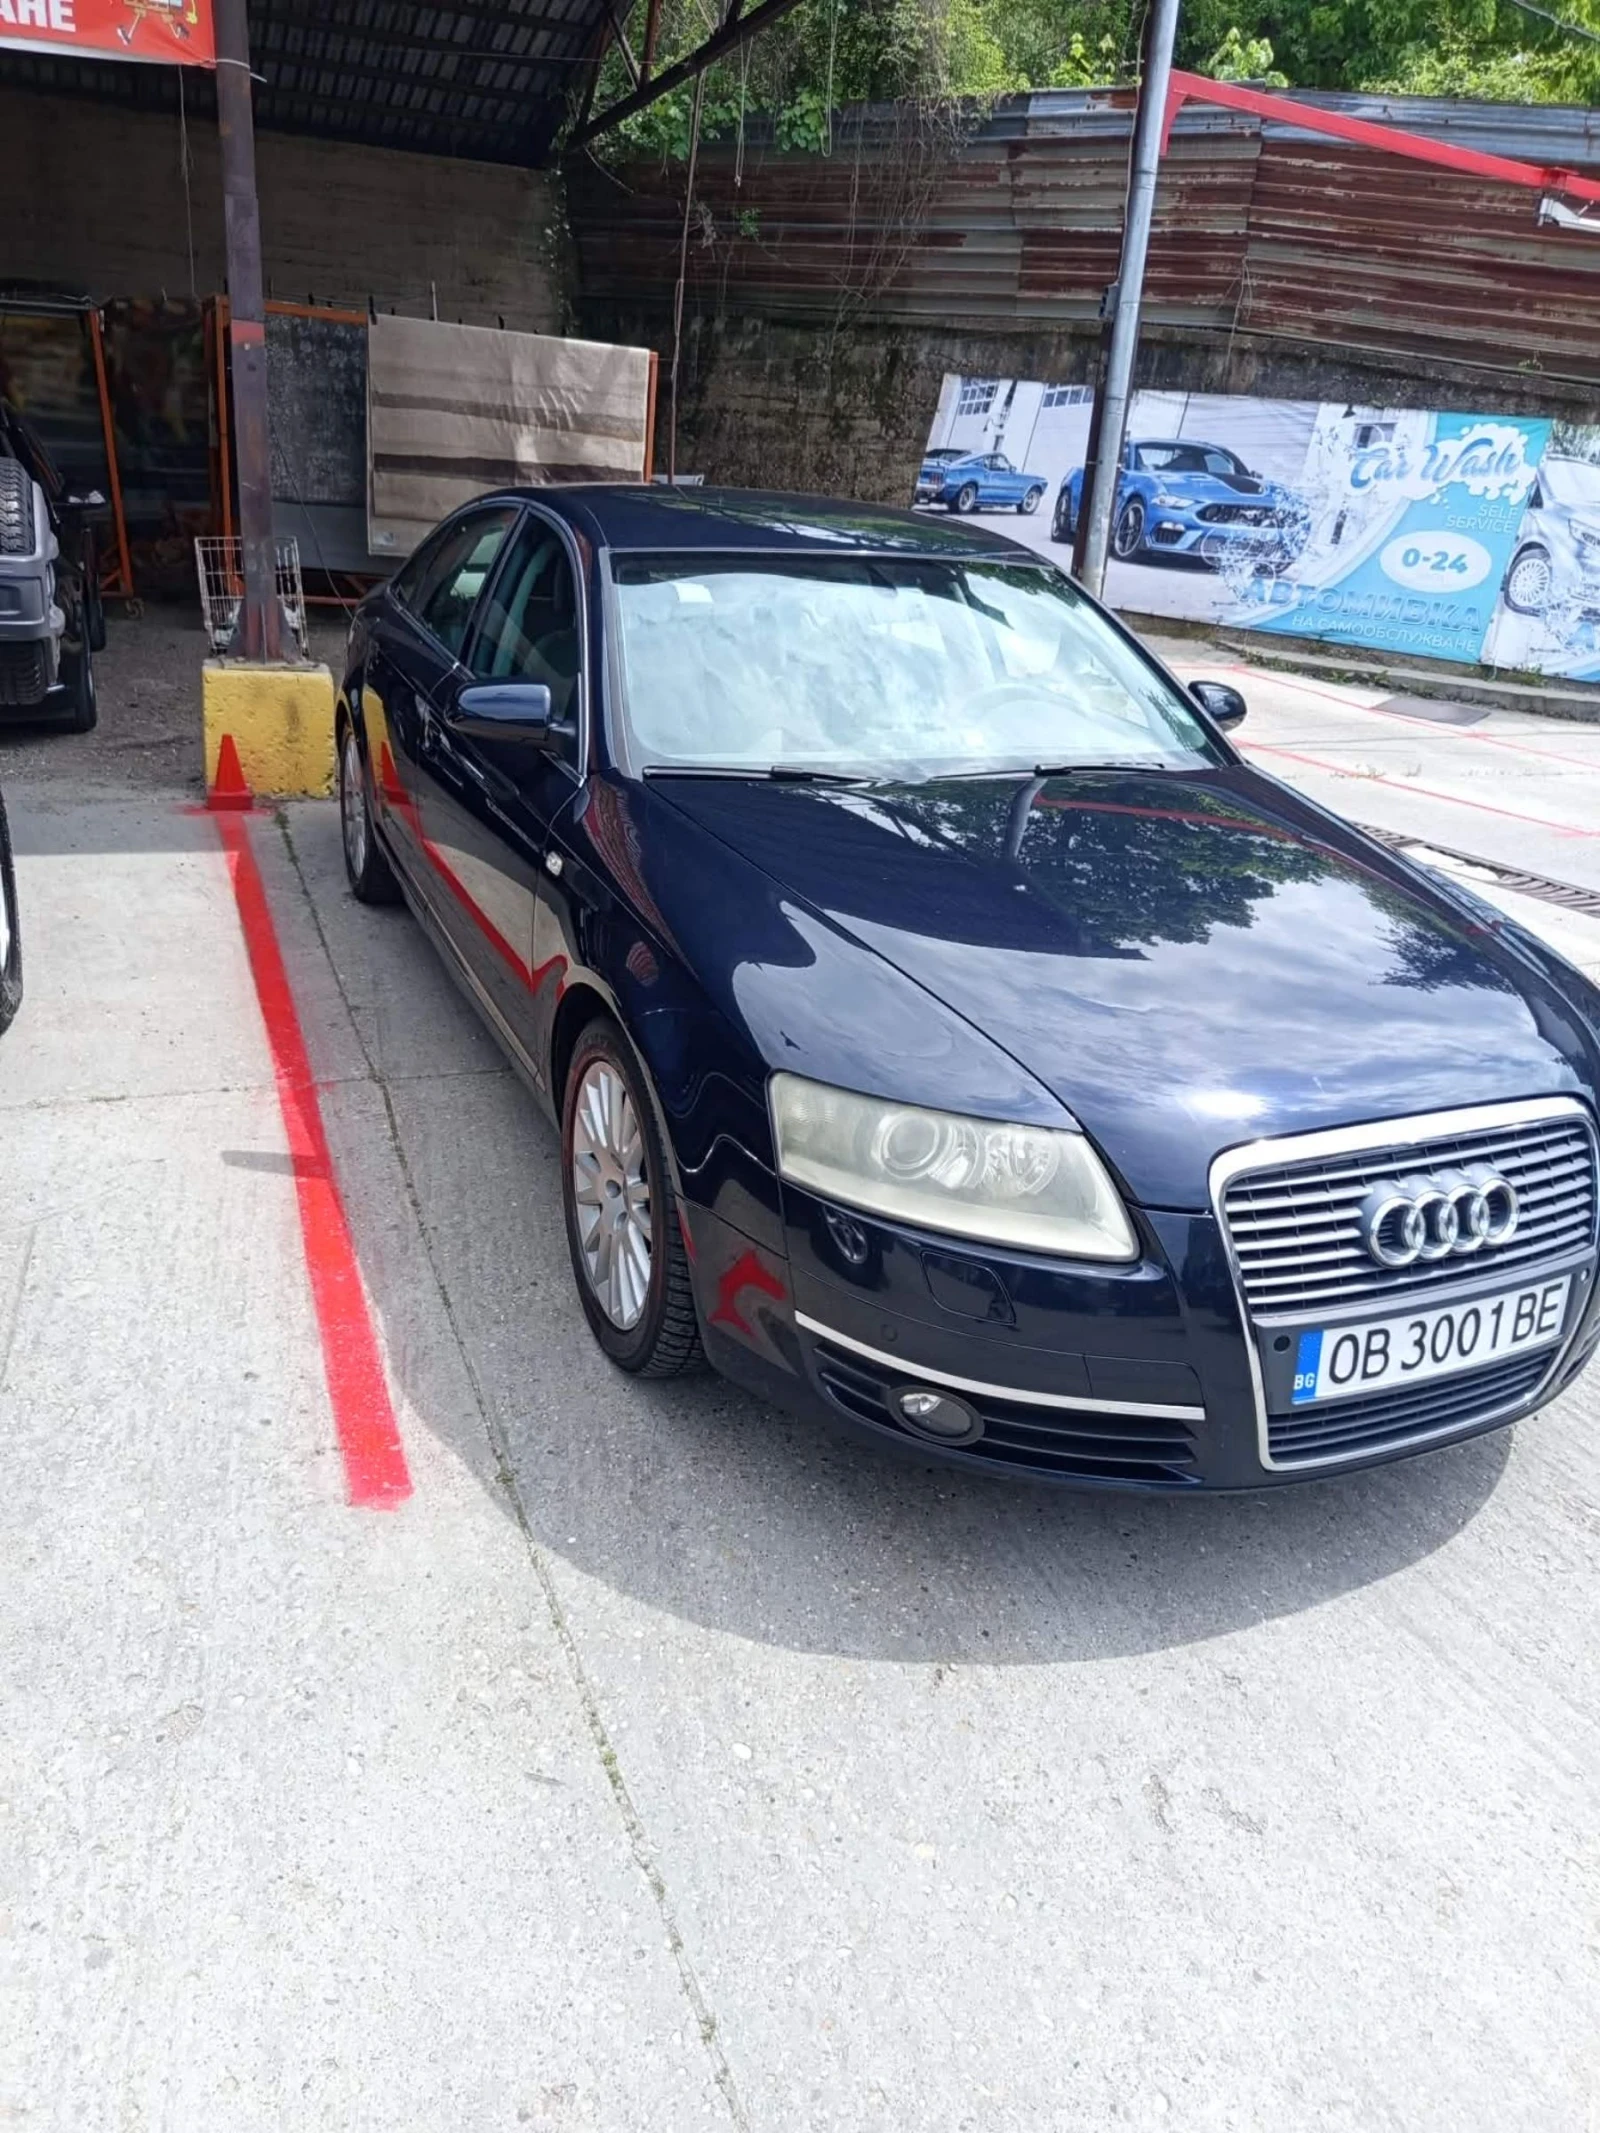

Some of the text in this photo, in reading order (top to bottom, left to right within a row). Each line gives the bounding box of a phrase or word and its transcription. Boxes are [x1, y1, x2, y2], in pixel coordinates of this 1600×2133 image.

[1350, 437, 1521, 489] Car Wash
[1446, 515, 1517, 534] SERVICE
[1478, 504, 1520, 521] SELF
[1402, 548, 1469, 574] 0-24
[1240, 576, 1481, 635] АВТОМИВКА
[1292, 615, 1478, 652] НА САМООБСЛУЖВАНЕ
[1293, 1373, 1317, 1391] BG
